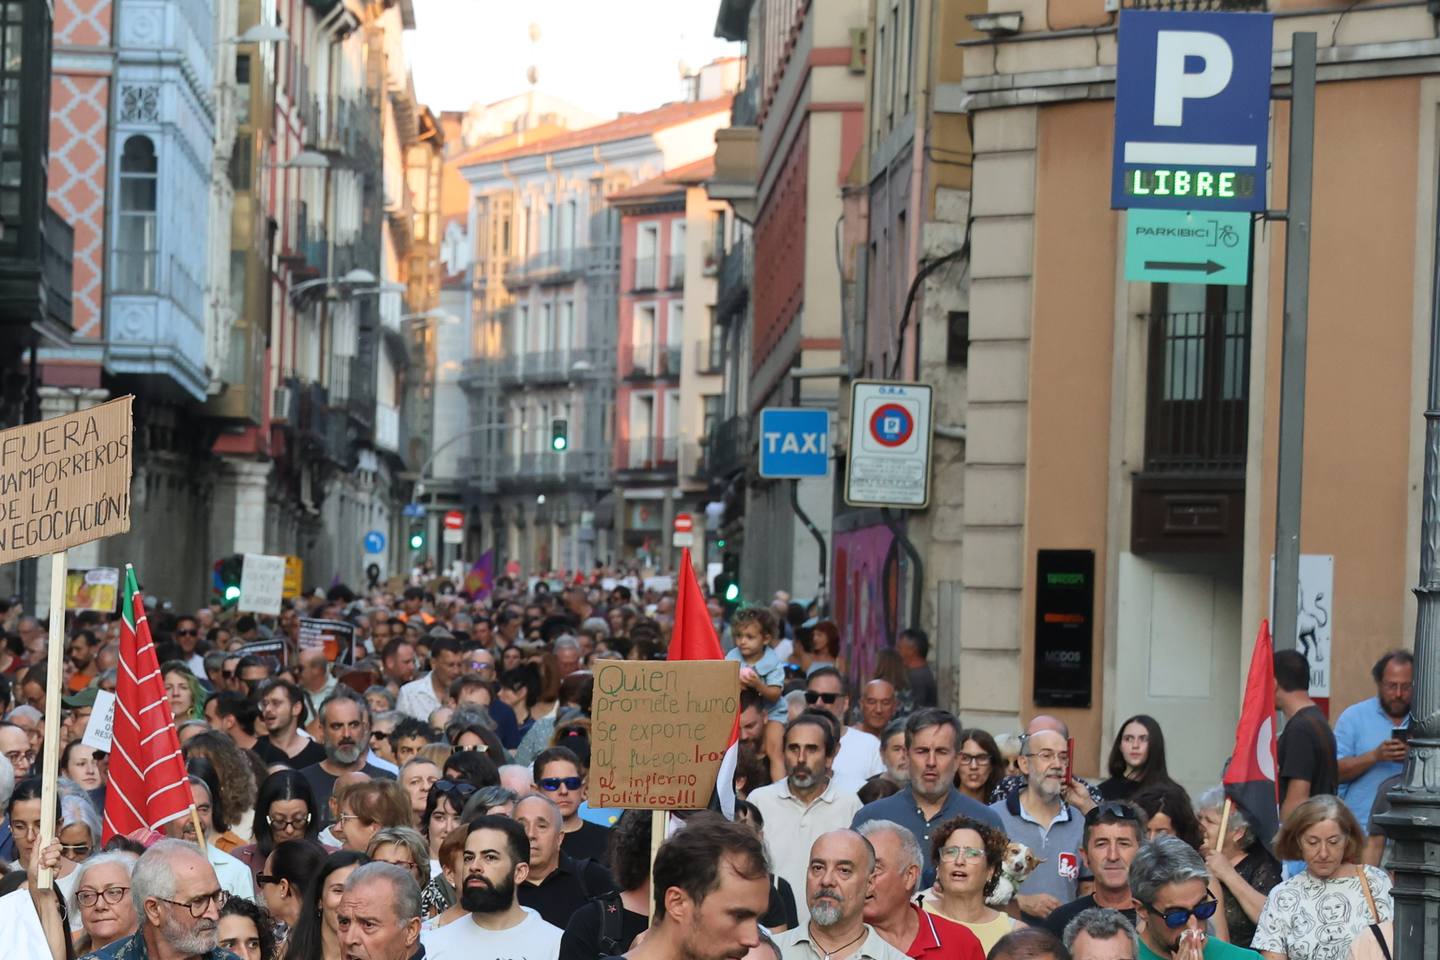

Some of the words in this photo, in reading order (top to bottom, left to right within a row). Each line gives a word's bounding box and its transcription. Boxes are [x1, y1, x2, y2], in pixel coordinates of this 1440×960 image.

[1153, 30, 1234, 127] P
[1133, 169, 1236, 197] LIBRE
[1136, 226, 1210, 239] PARKIBICI
[764, 432, 827, 454] TAXI
[31, 487, 58, 515] LA
[598, 665, 678, 697] Quien
[596, 692, 680, 721] promete
[686, 691, 737, 715] humo
[629, 722, 707, 750] expone
[599, 766, 616, 791] al
[629, 772, 697, 796] infierno
